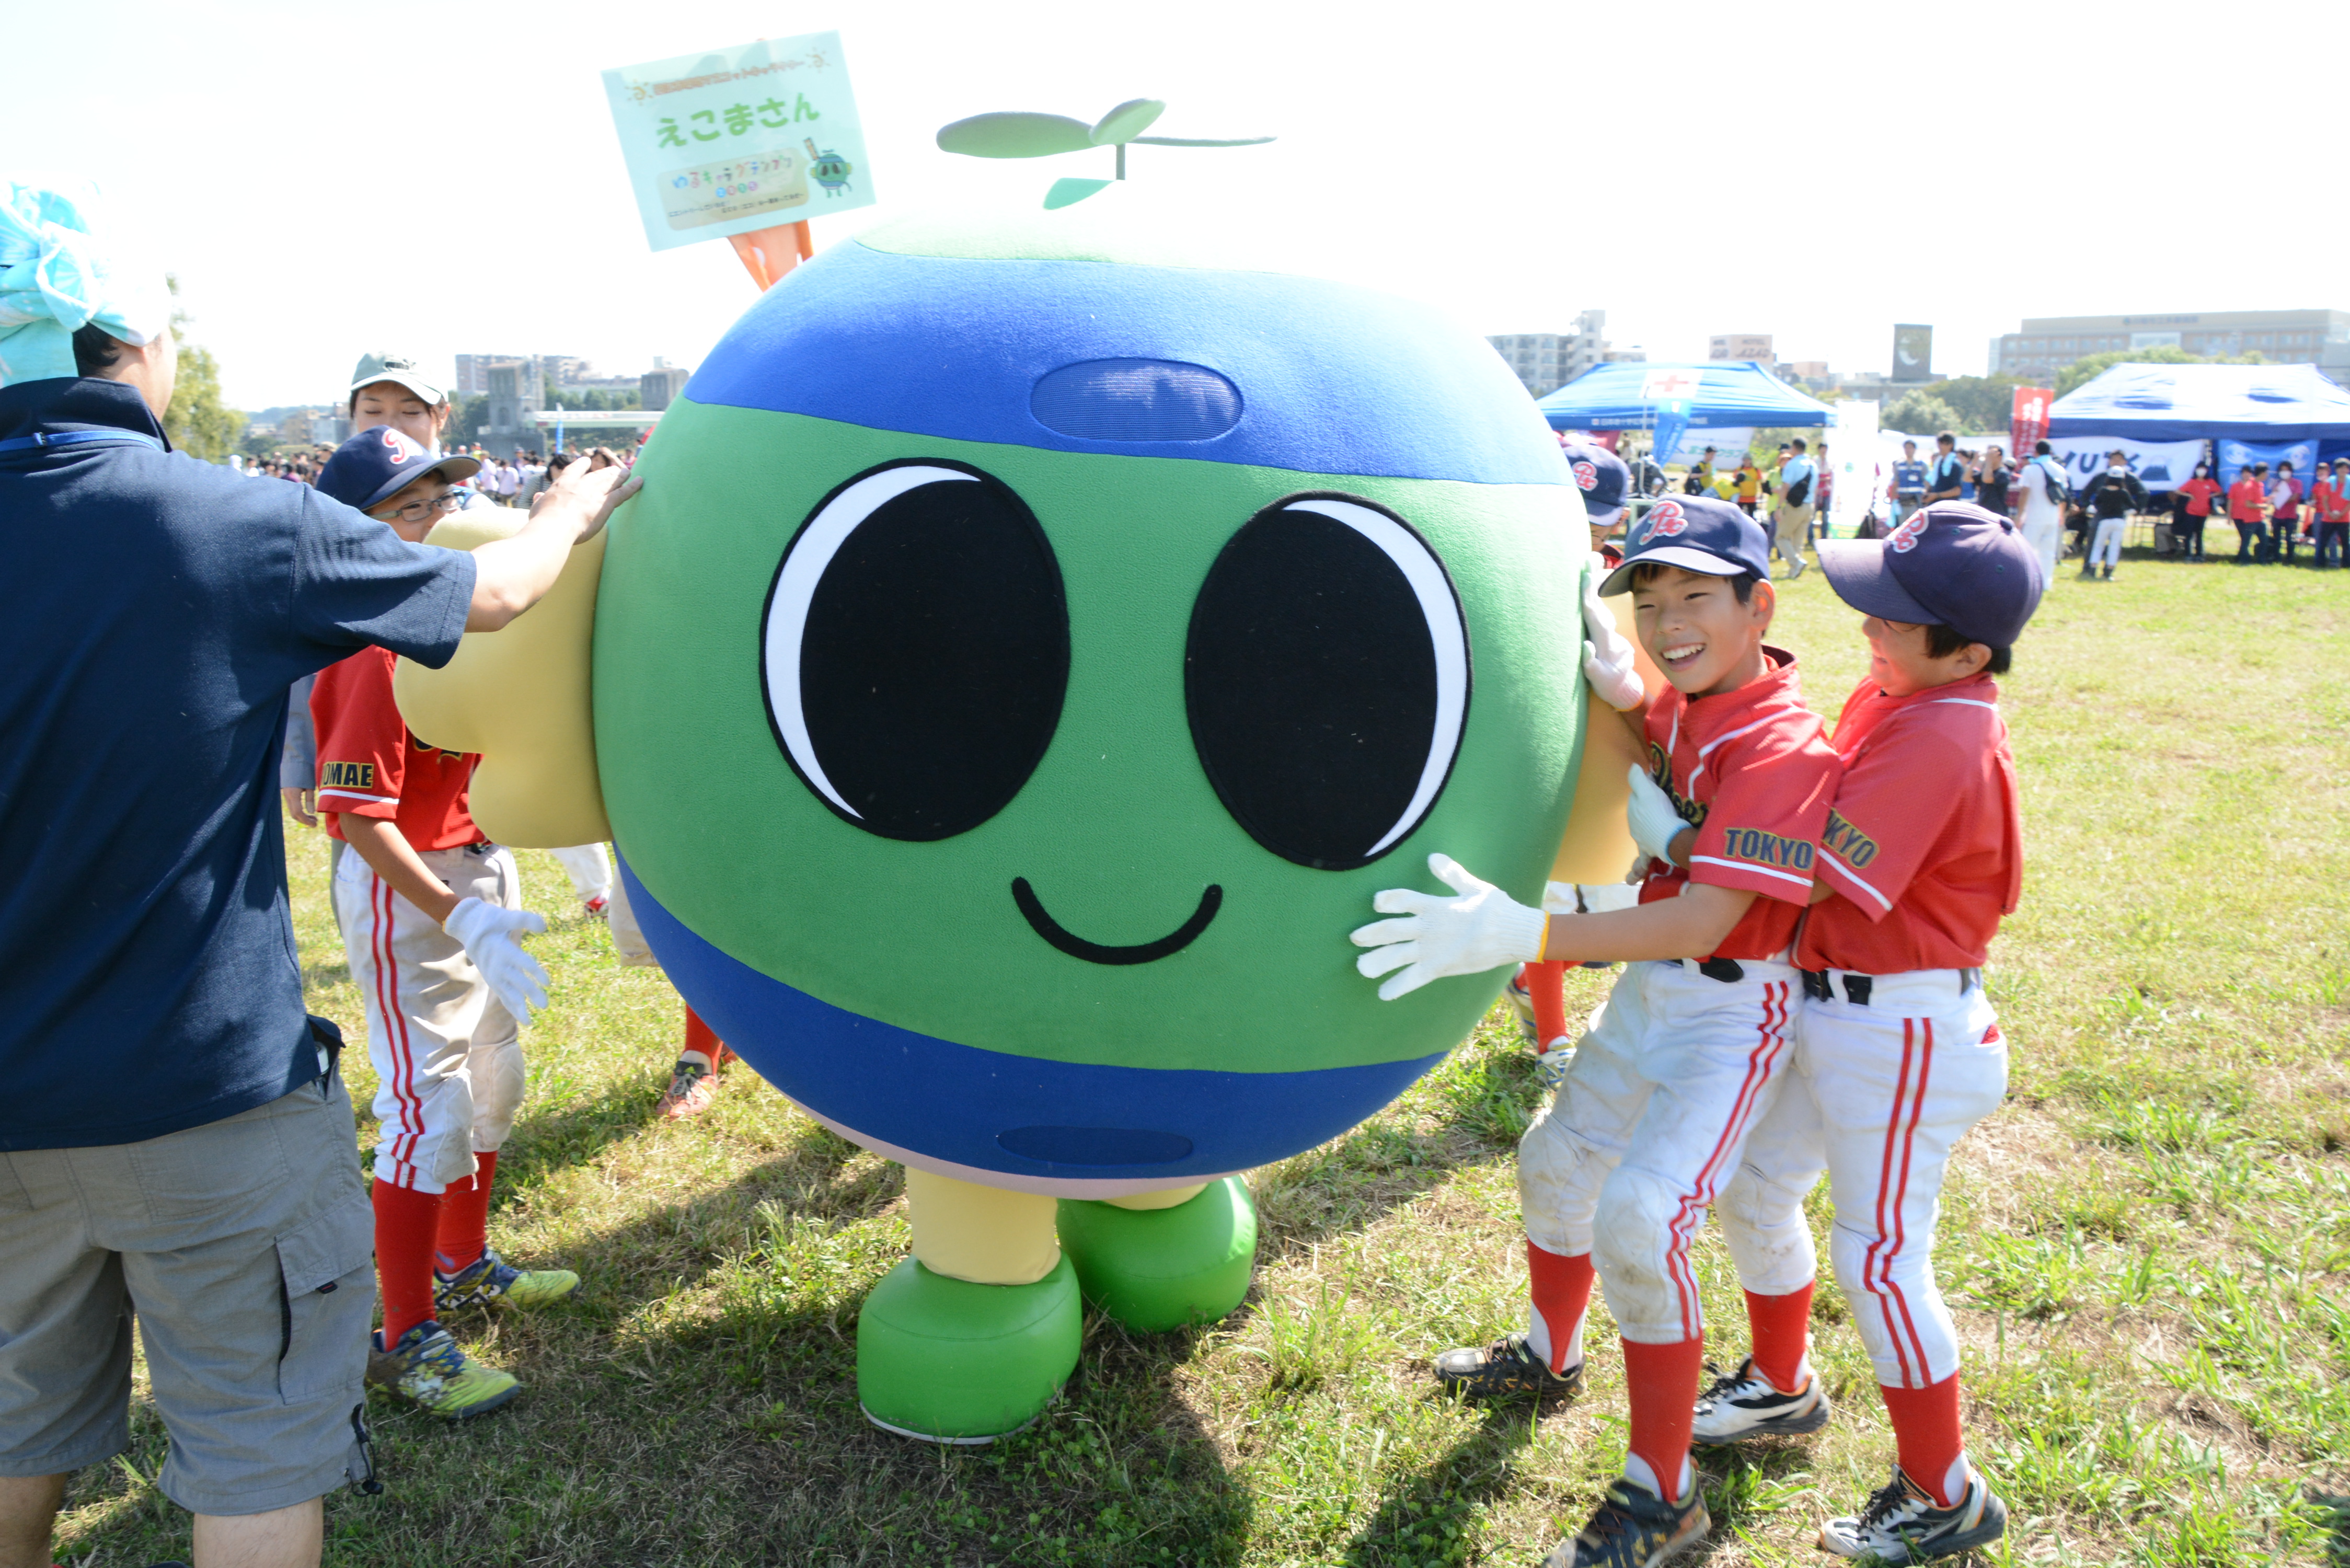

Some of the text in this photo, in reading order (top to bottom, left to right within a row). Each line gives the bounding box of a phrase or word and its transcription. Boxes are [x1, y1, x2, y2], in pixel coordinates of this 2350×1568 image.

[657, 93, 820, 147] えこまさん
[1724, 827, 1815, 871] TOKYO
